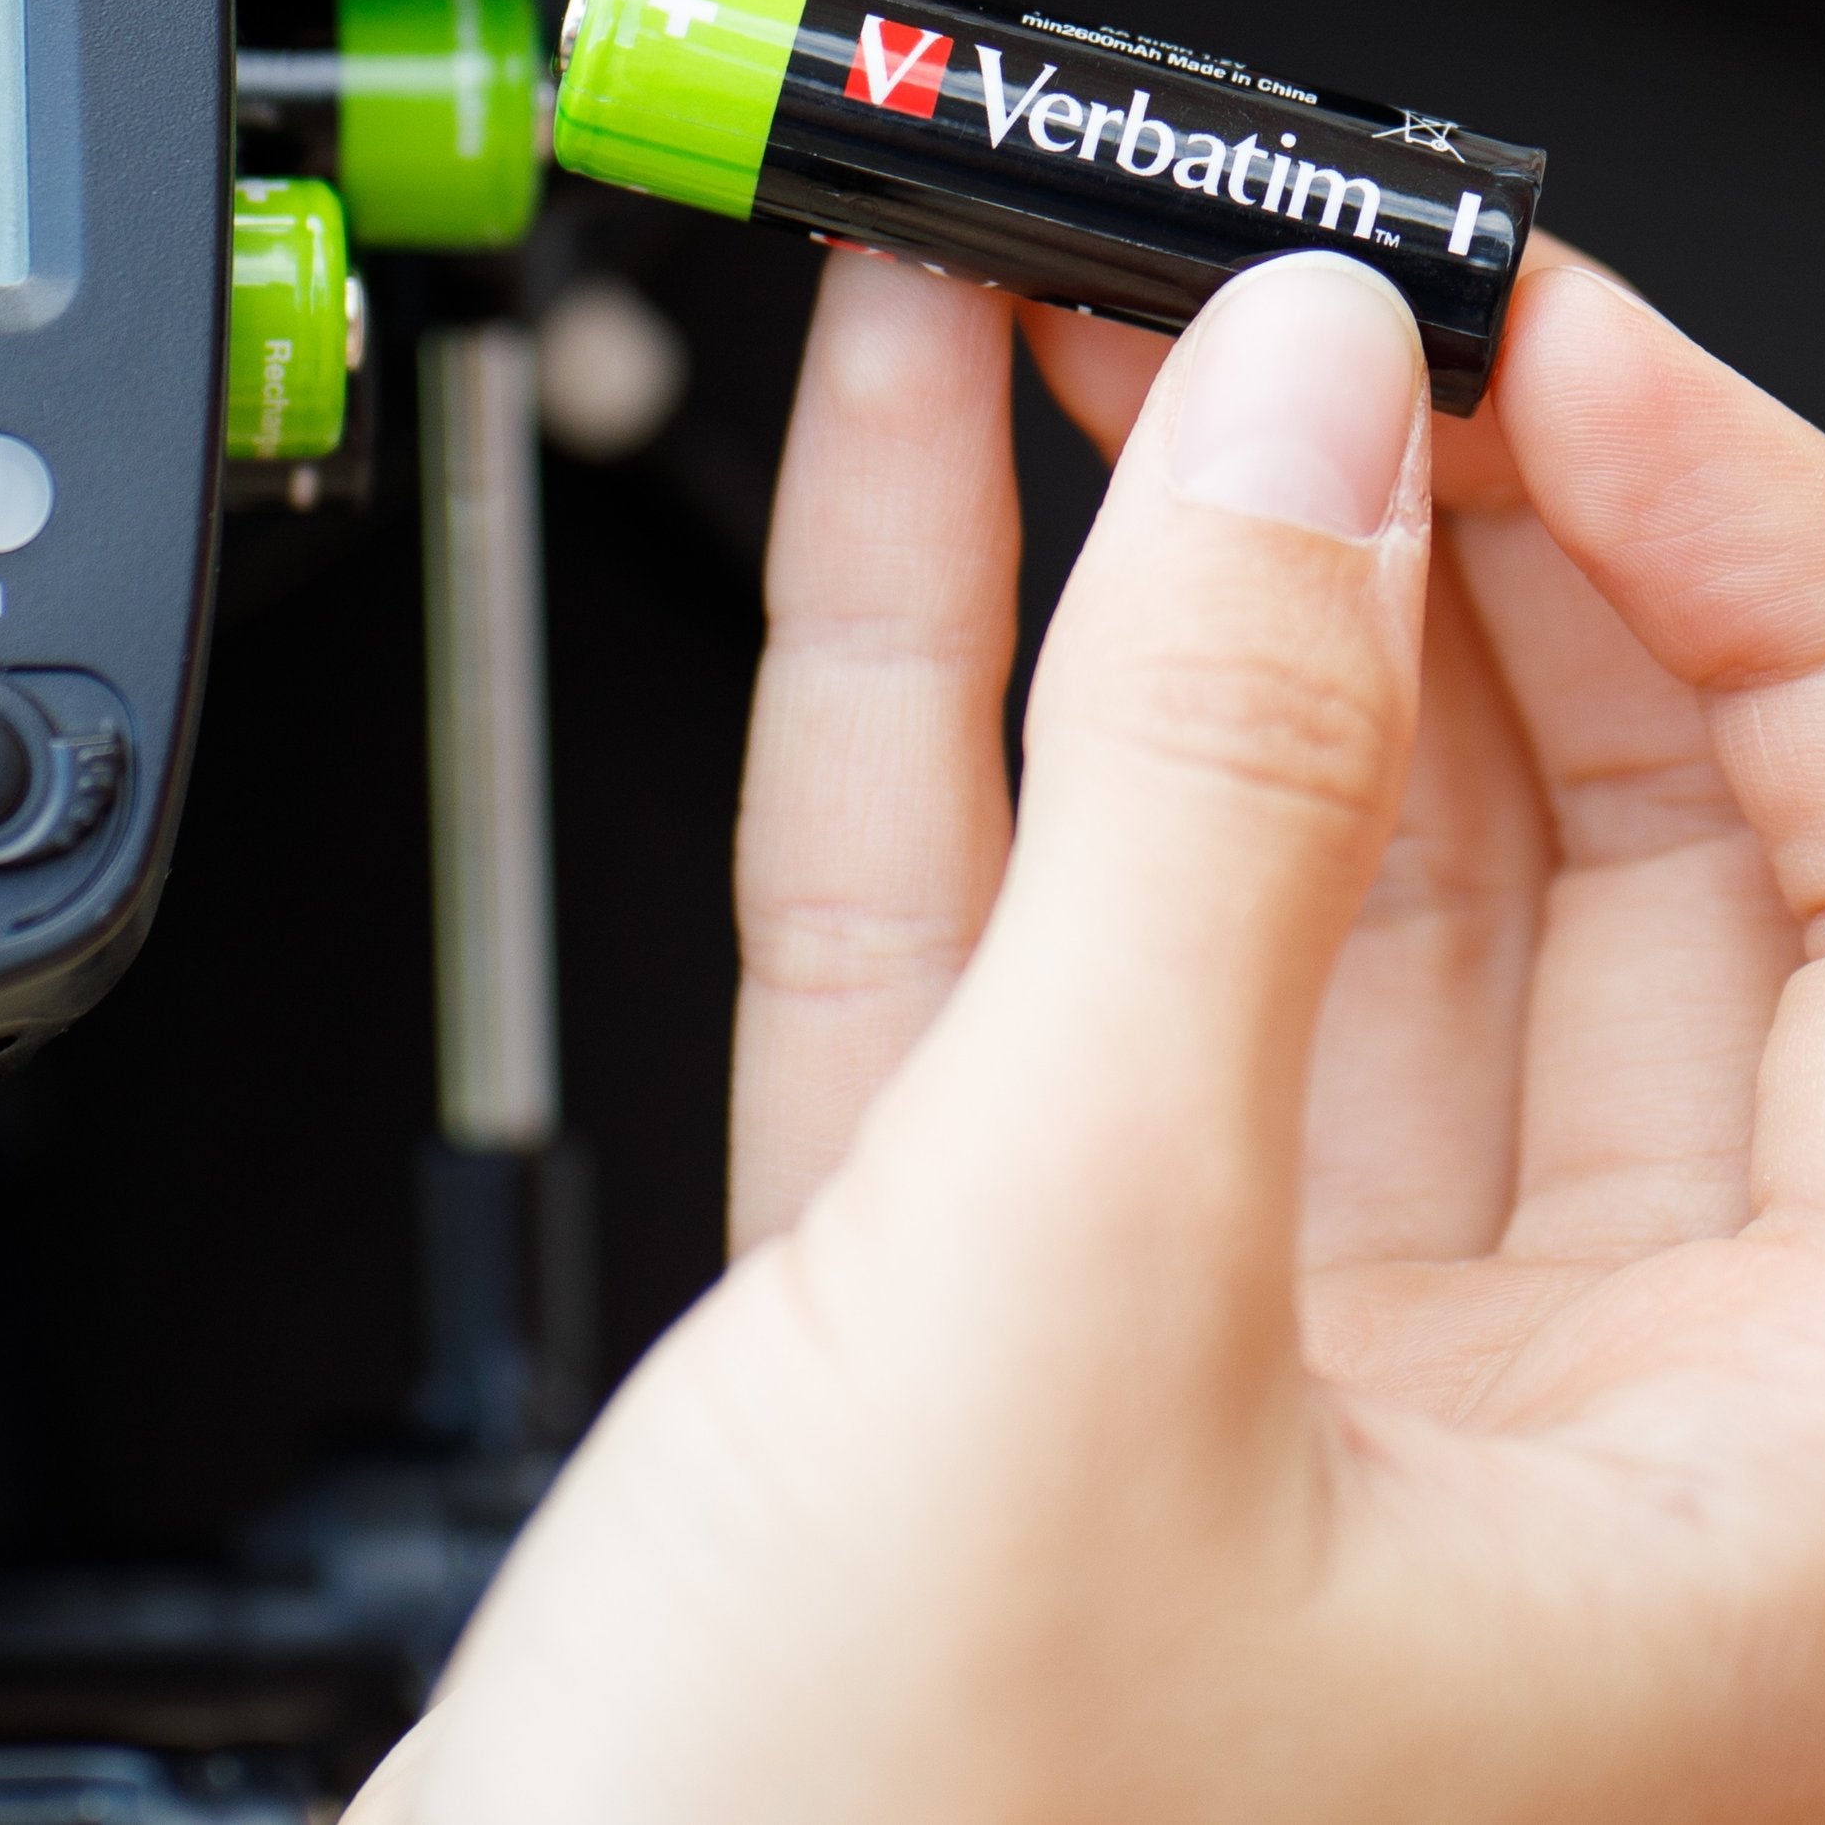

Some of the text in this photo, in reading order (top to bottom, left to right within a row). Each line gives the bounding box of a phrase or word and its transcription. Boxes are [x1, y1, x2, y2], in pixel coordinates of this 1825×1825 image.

[1021, 12, 1319, 106] min2600mAh Made in China
[975, 43, 1381, 240] Verbatim
